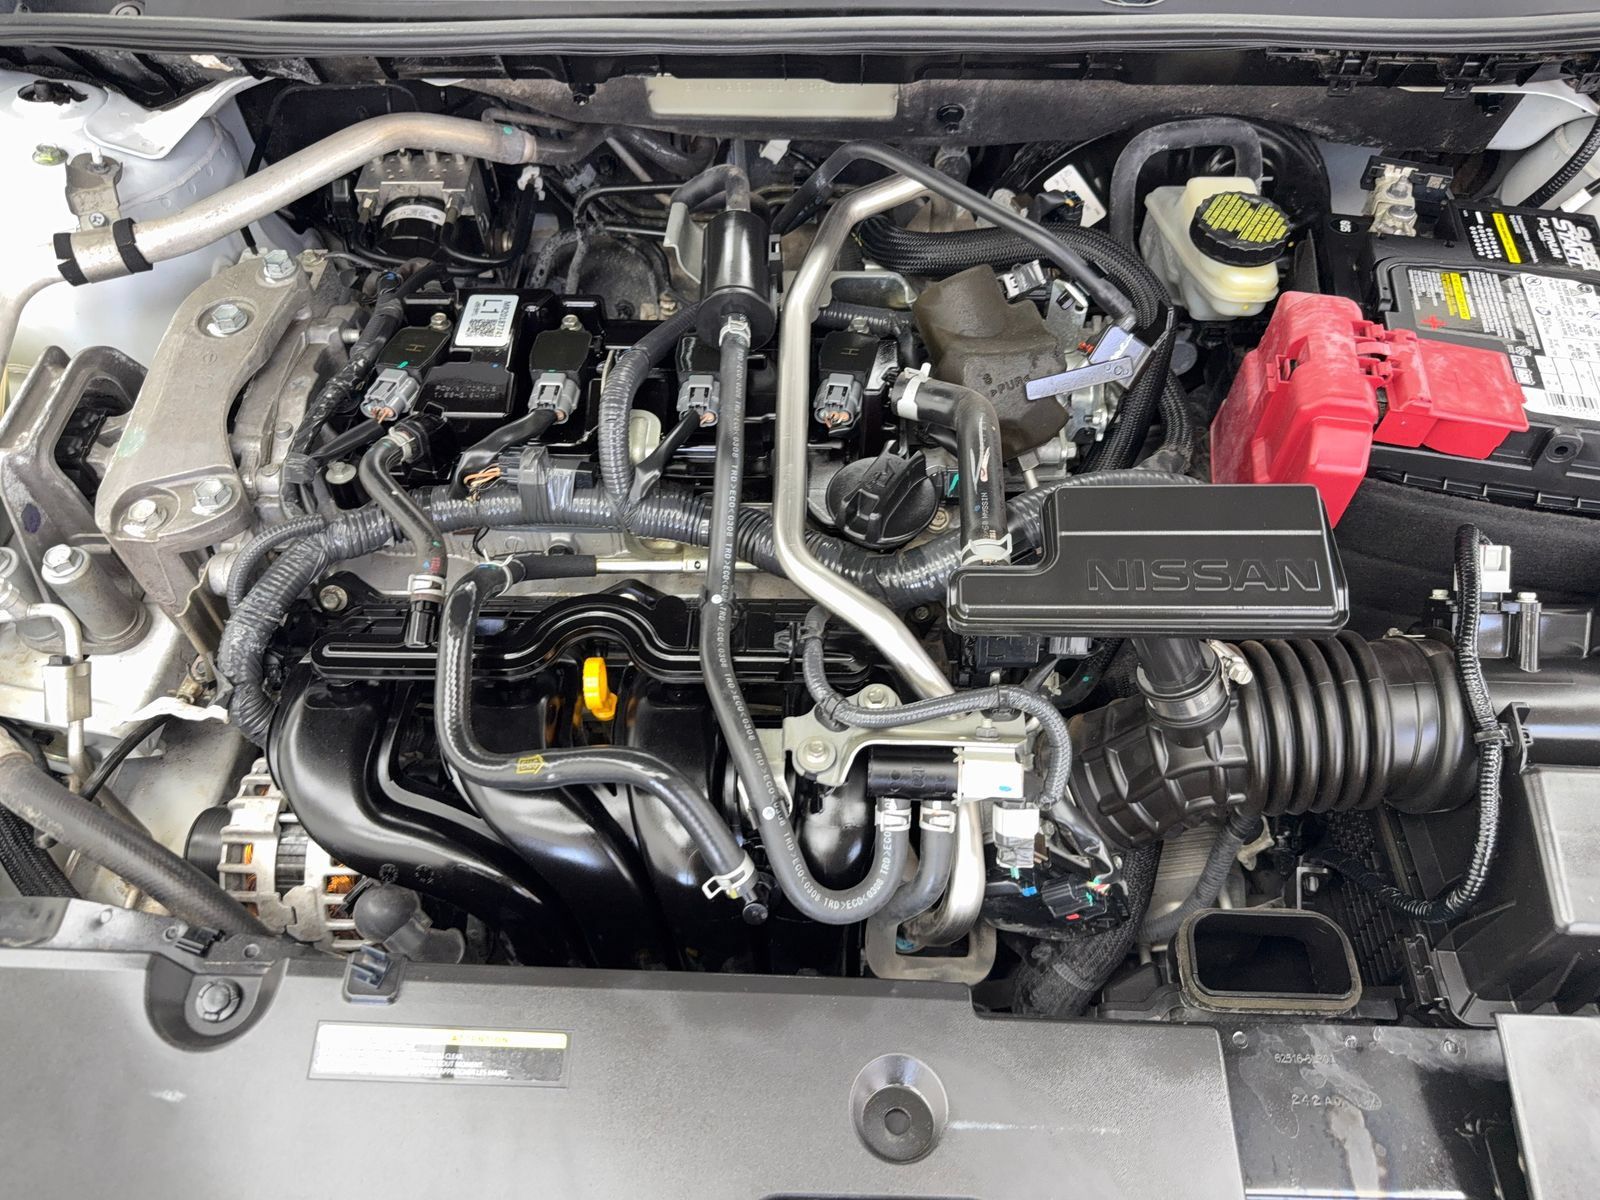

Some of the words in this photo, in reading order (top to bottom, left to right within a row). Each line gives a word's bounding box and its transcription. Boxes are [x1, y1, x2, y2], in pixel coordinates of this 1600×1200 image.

[1537, 217, 1563, 258] PLATINUM
[1551, 217, 1583, 266] START
[1086, 559, 1321, 592] NISSAN
